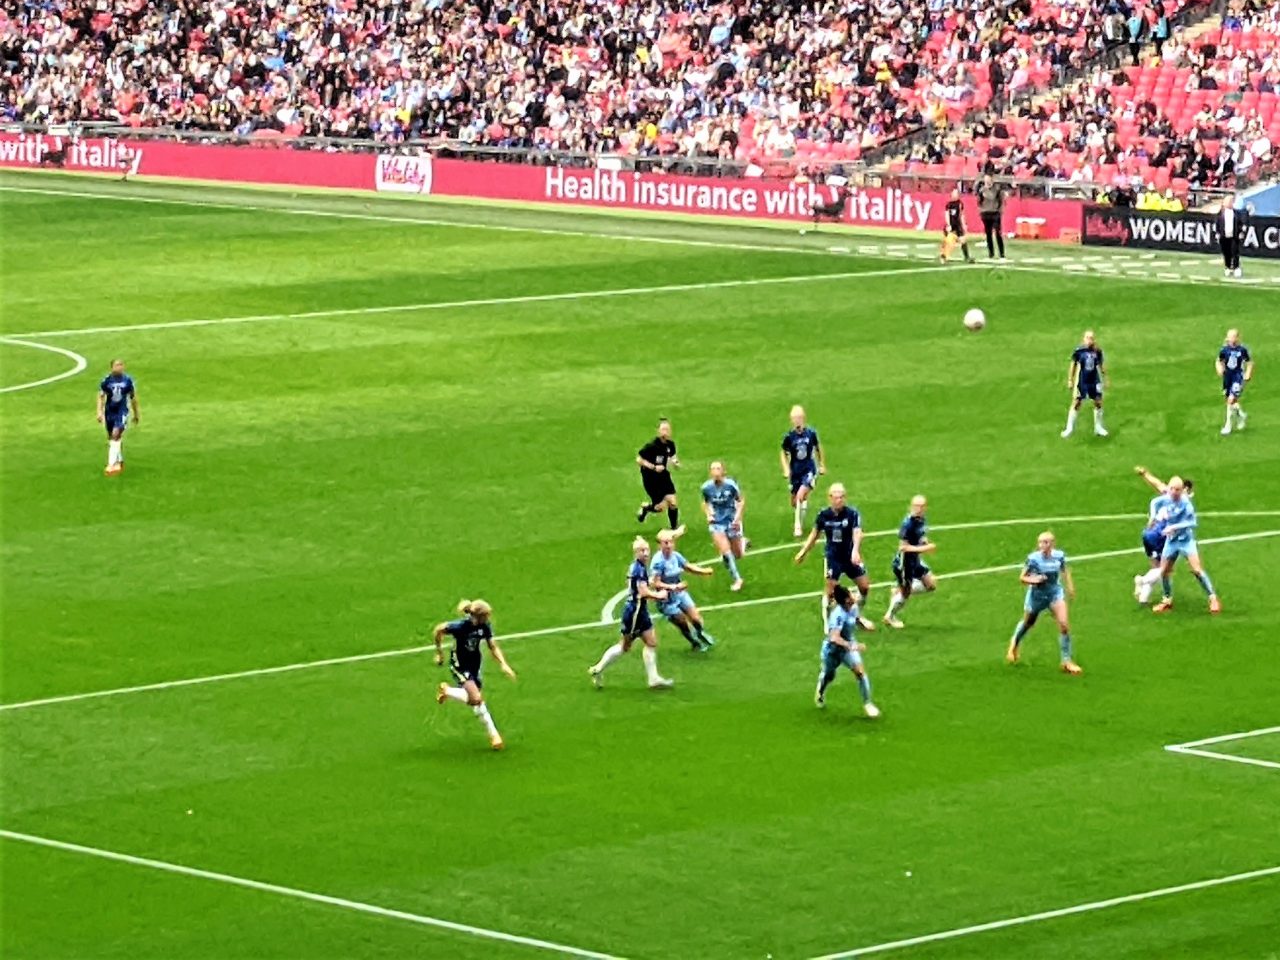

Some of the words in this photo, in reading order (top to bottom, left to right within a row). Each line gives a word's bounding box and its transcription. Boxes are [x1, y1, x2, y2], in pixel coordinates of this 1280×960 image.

[0, 133, 48, 164] with
[545, 167, 626, 203] Health
[633, 172, 757, 211] insurance
[764, 181, 824, 215] with
[1129, 218, 1220, 246] WOMEN'
